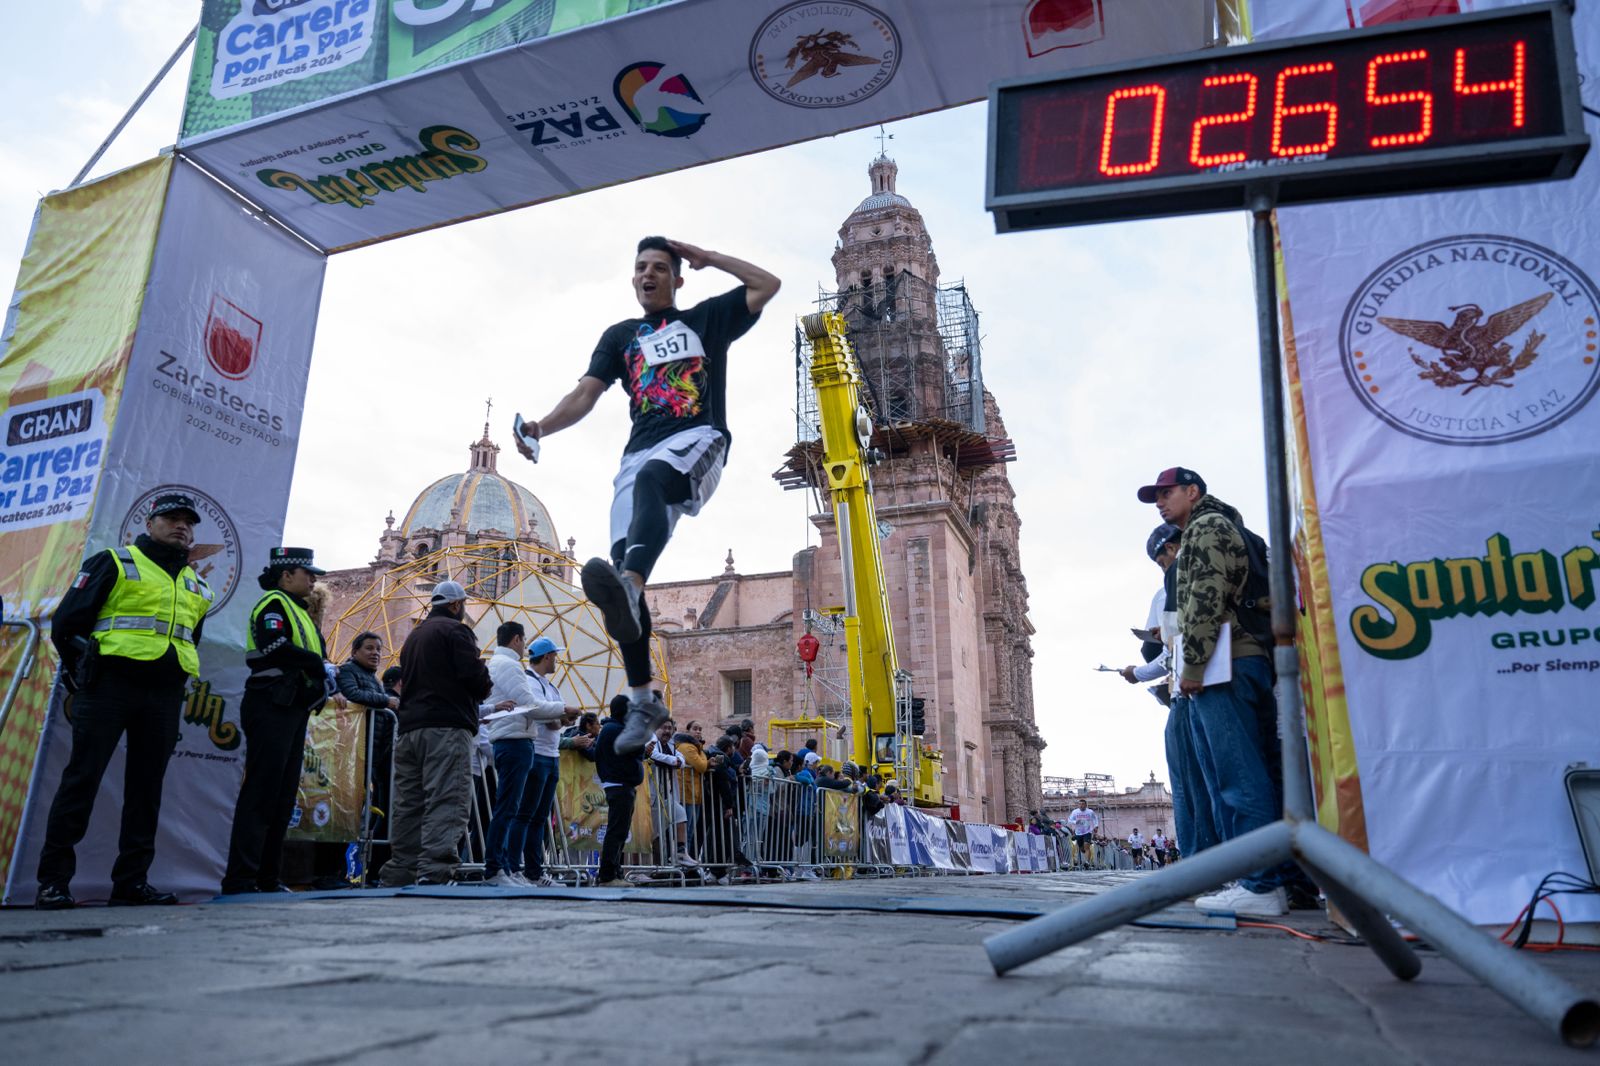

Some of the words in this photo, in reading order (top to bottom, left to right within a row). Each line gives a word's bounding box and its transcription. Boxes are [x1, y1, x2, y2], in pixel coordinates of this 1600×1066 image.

[226, 0, 371, 56] Carrera
[767, 21, 789, 39] PAZ
[797, 6, 854, 19] JUSTICIA
[222, 52, 272, 85] por
[277, 44, 310, 65] La
[318, 21, 364, 55] Paz
[241, 63, 307, 87] Zacatecas
[310, 52, 342, 68] 2024
[848, 49, 894, 99] GUARDIA
[507, 96, 601, 122] ZACATECAS
[771, 82, 846, 105] NACIONAL
[514, 106, 622, 146] PAZ
[318, 142, 387, 165] GRUPO
[1355, 253, 1444, 336] GUARDIA
[1450, 246, 1582, 307] NACIONAL
[654, 333, 688, 358] 557
[156, 350, 284, 431] Zacatecas
[20, 407, 82, 440] GRAN
[152, 379, 212, 415] GOBIERNO
[215, 410, 236, 427] DEL
[240, 422, 280, 447] ESTADO
[1404, 406, 1505, 432] JUSTICIA
[1506, 409, 1522, 424] Y
[1526, 388, 1566, 418] PAZ
[186, 414, 243, 446] 2021-2027
[20, 483, 49, 506] La
[53, 474, 94, 500] Paz
[46, 501, 73, 517] 2024
[193, 496, 235, 558] NACIONAL
[1350, 524, 1600, 660] Santar
